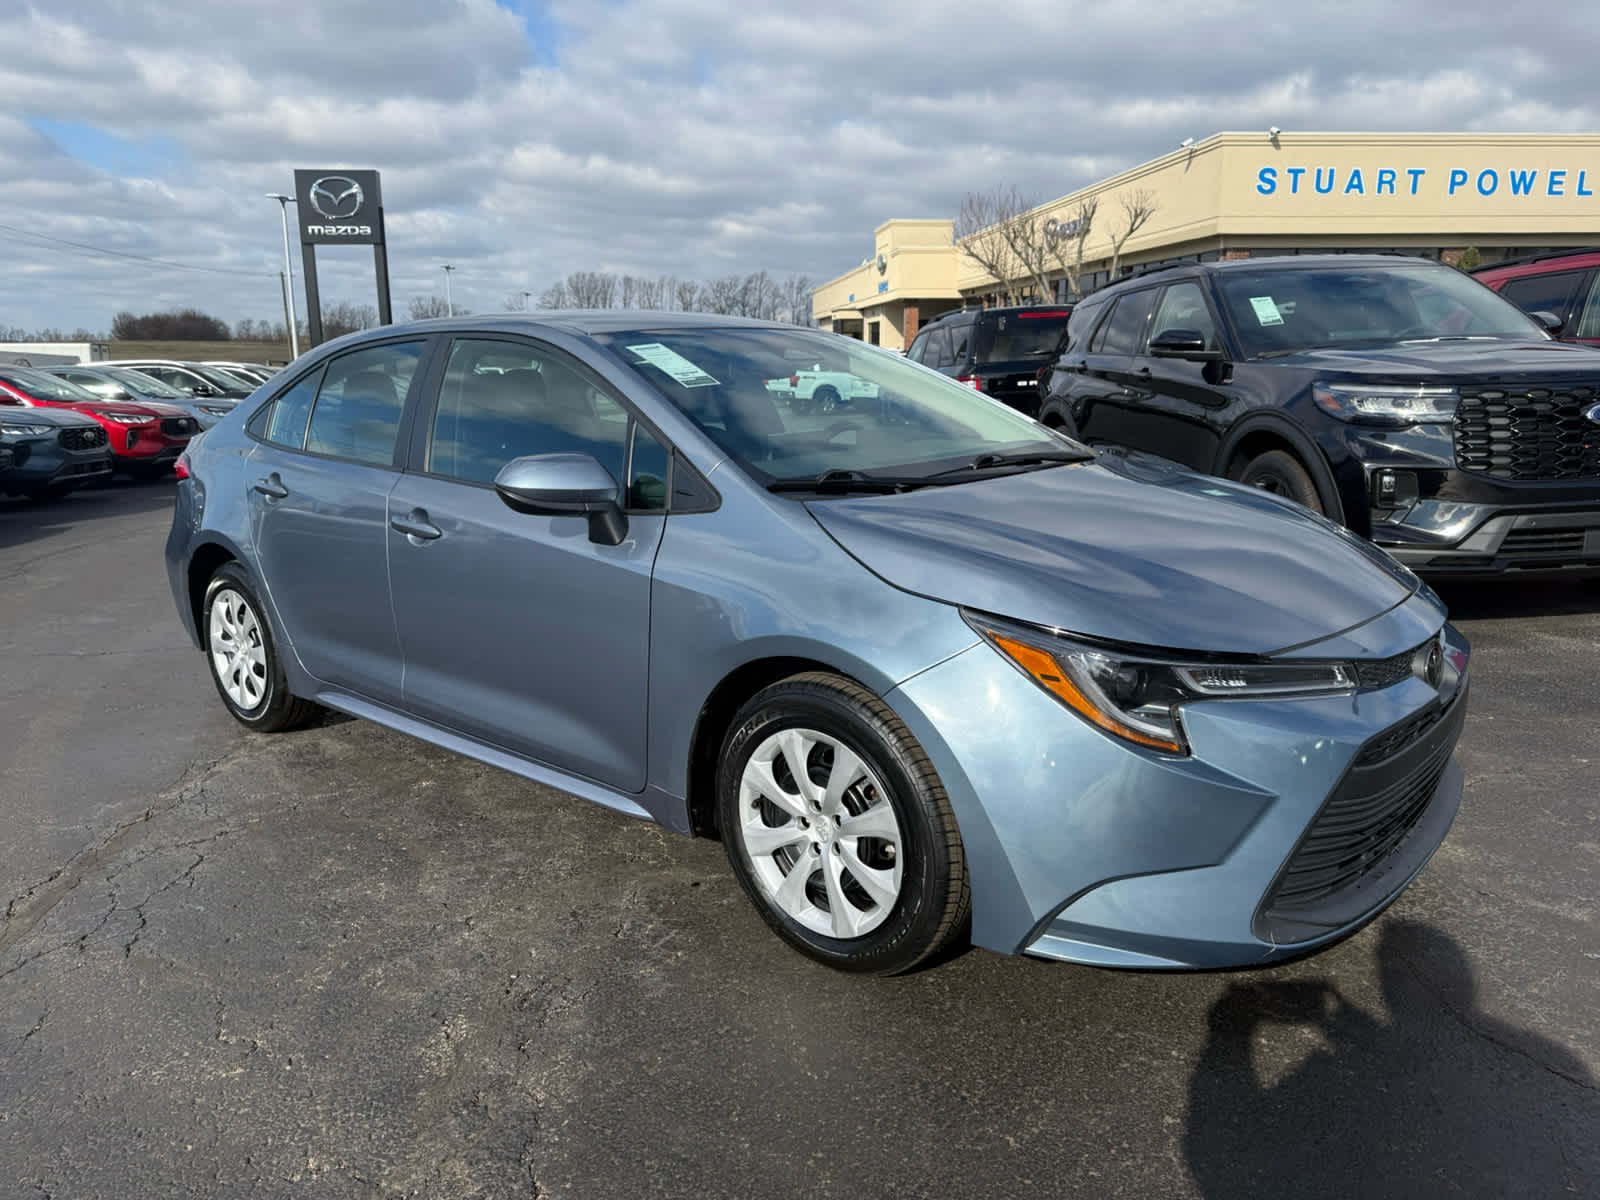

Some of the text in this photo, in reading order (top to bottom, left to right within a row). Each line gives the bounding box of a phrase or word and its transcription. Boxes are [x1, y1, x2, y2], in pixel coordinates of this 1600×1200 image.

[1255, 167, 1593, 196] STUART POWEL
[307, 225, 372, 237] mazda
